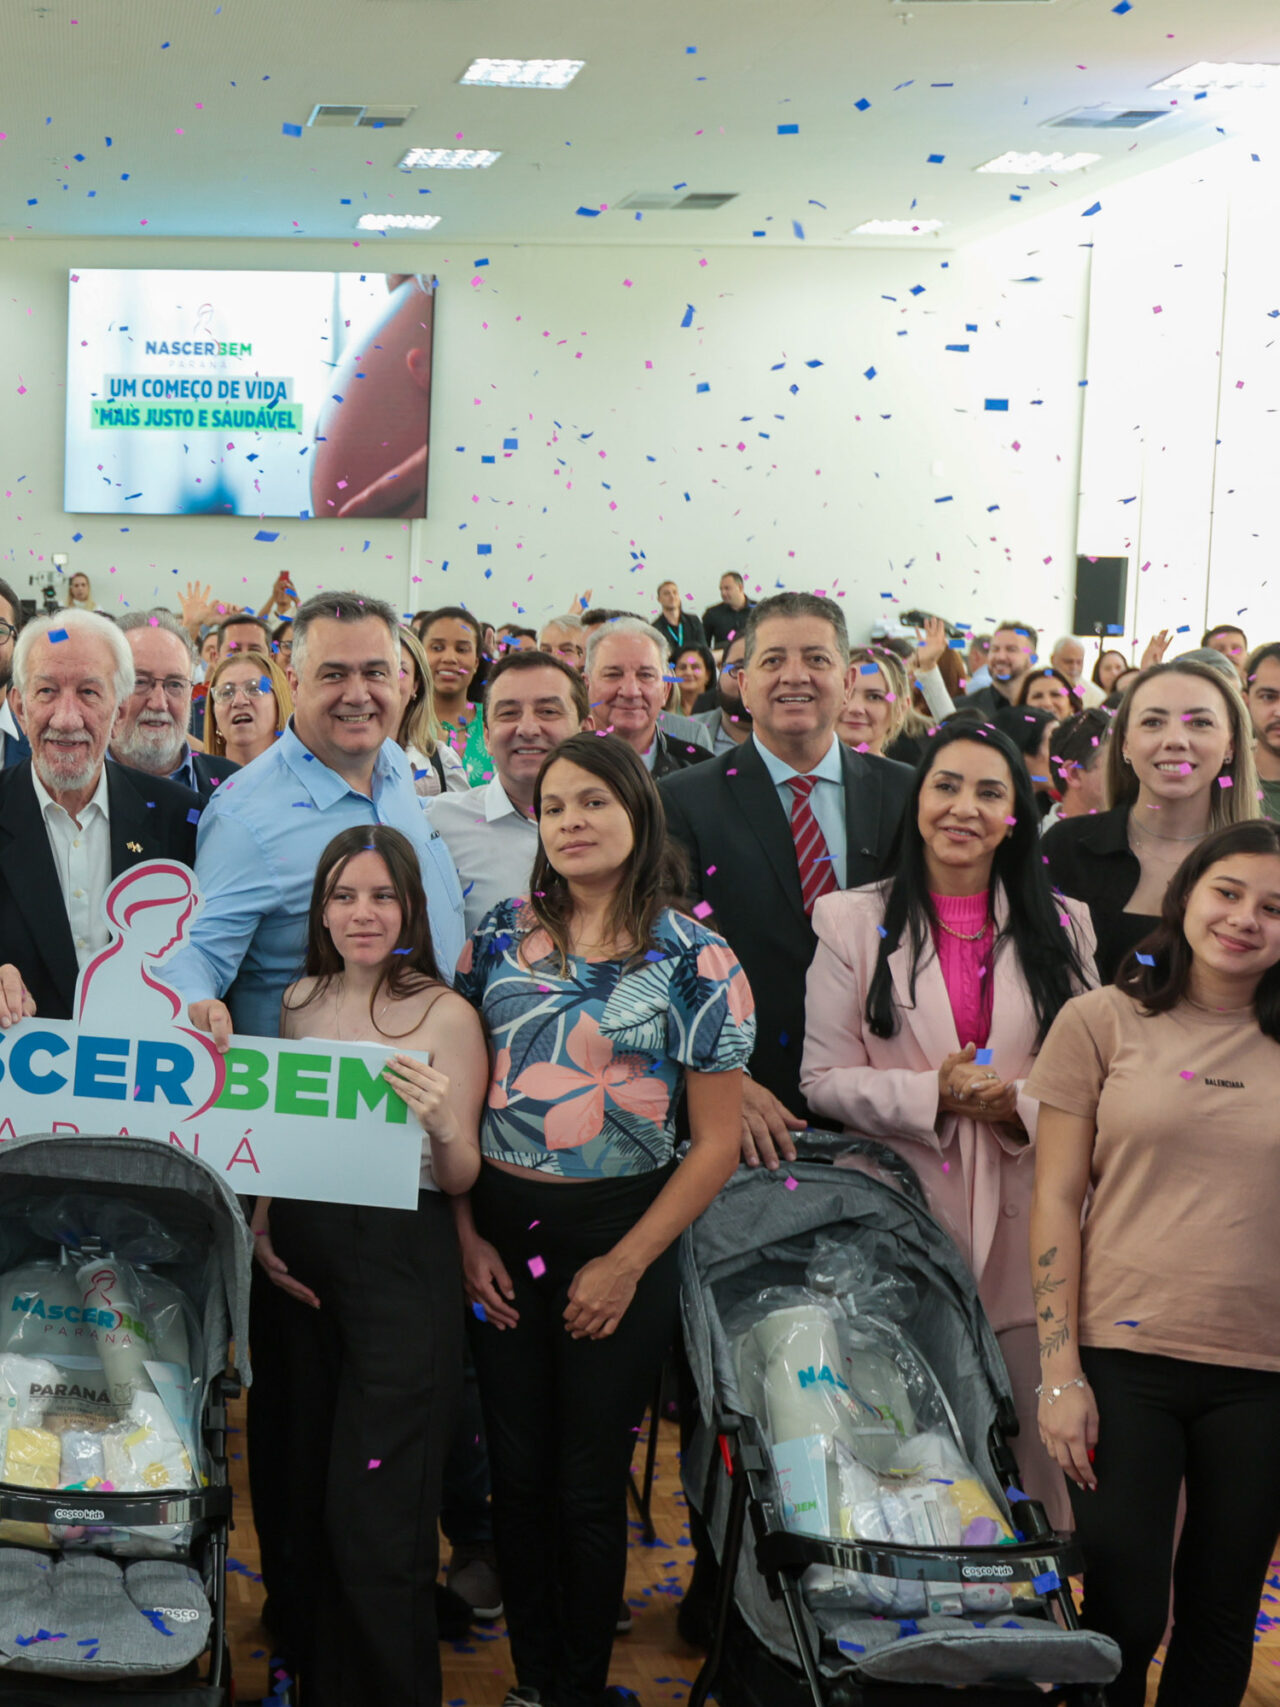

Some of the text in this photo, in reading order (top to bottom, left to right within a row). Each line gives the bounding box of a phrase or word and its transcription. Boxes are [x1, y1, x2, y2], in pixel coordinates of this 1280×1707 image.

[145, 340, 216, 356] NASCER
[110, 378, 287, 402] UM COMEÇO DE VIDA
[99, 406, 296, 429] MAIS JUSTO E SAUDÁVEL
[213, 1048, 410, 1124] BEM
